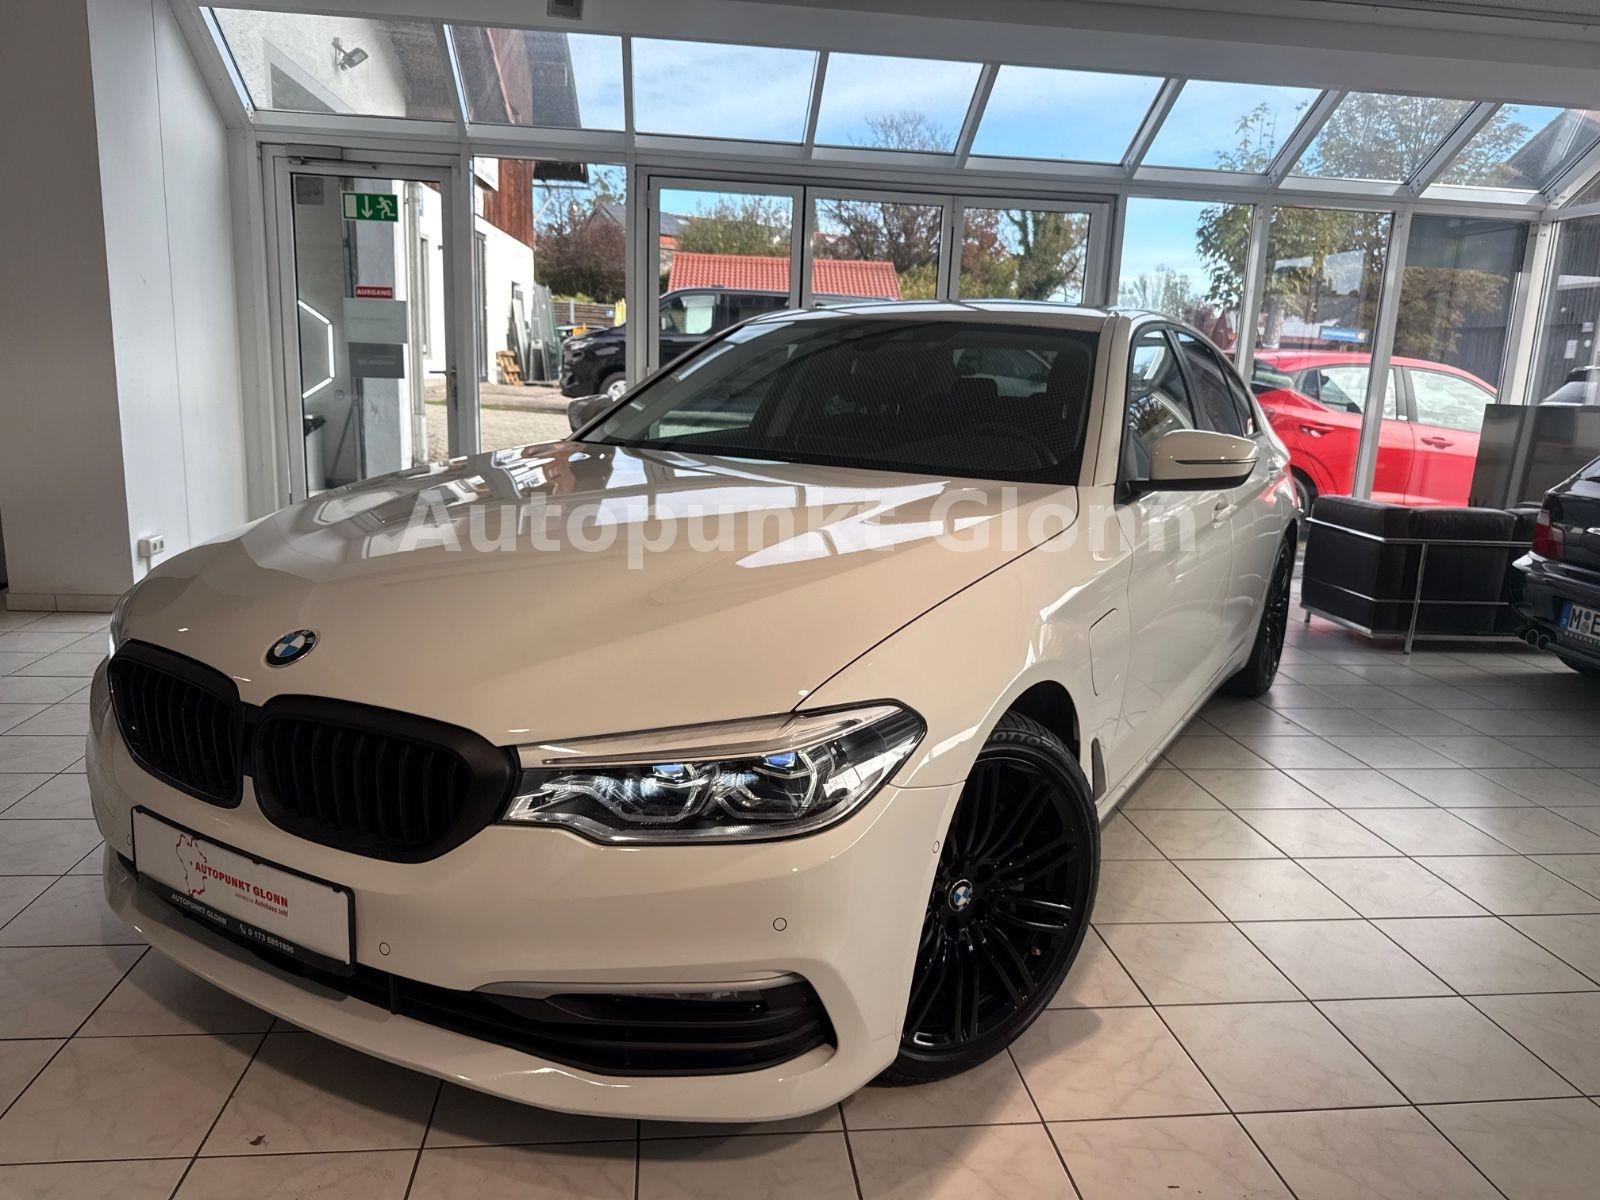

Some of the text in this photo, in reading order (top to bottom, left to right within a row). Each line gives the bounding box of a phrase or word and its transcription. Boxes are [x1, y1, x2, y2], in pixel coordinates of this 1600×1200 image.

[356, 288, 392, 297] AUSGANG
[1569, 607, 1583, 630] M
[195, 861, 251, 893] AUTOPUNKT
[253, 885, 288, 908] GLONN
[172, 893, 227, 926] AUTOPUNKT GLONN
[254, 930, 265, 942] 173
